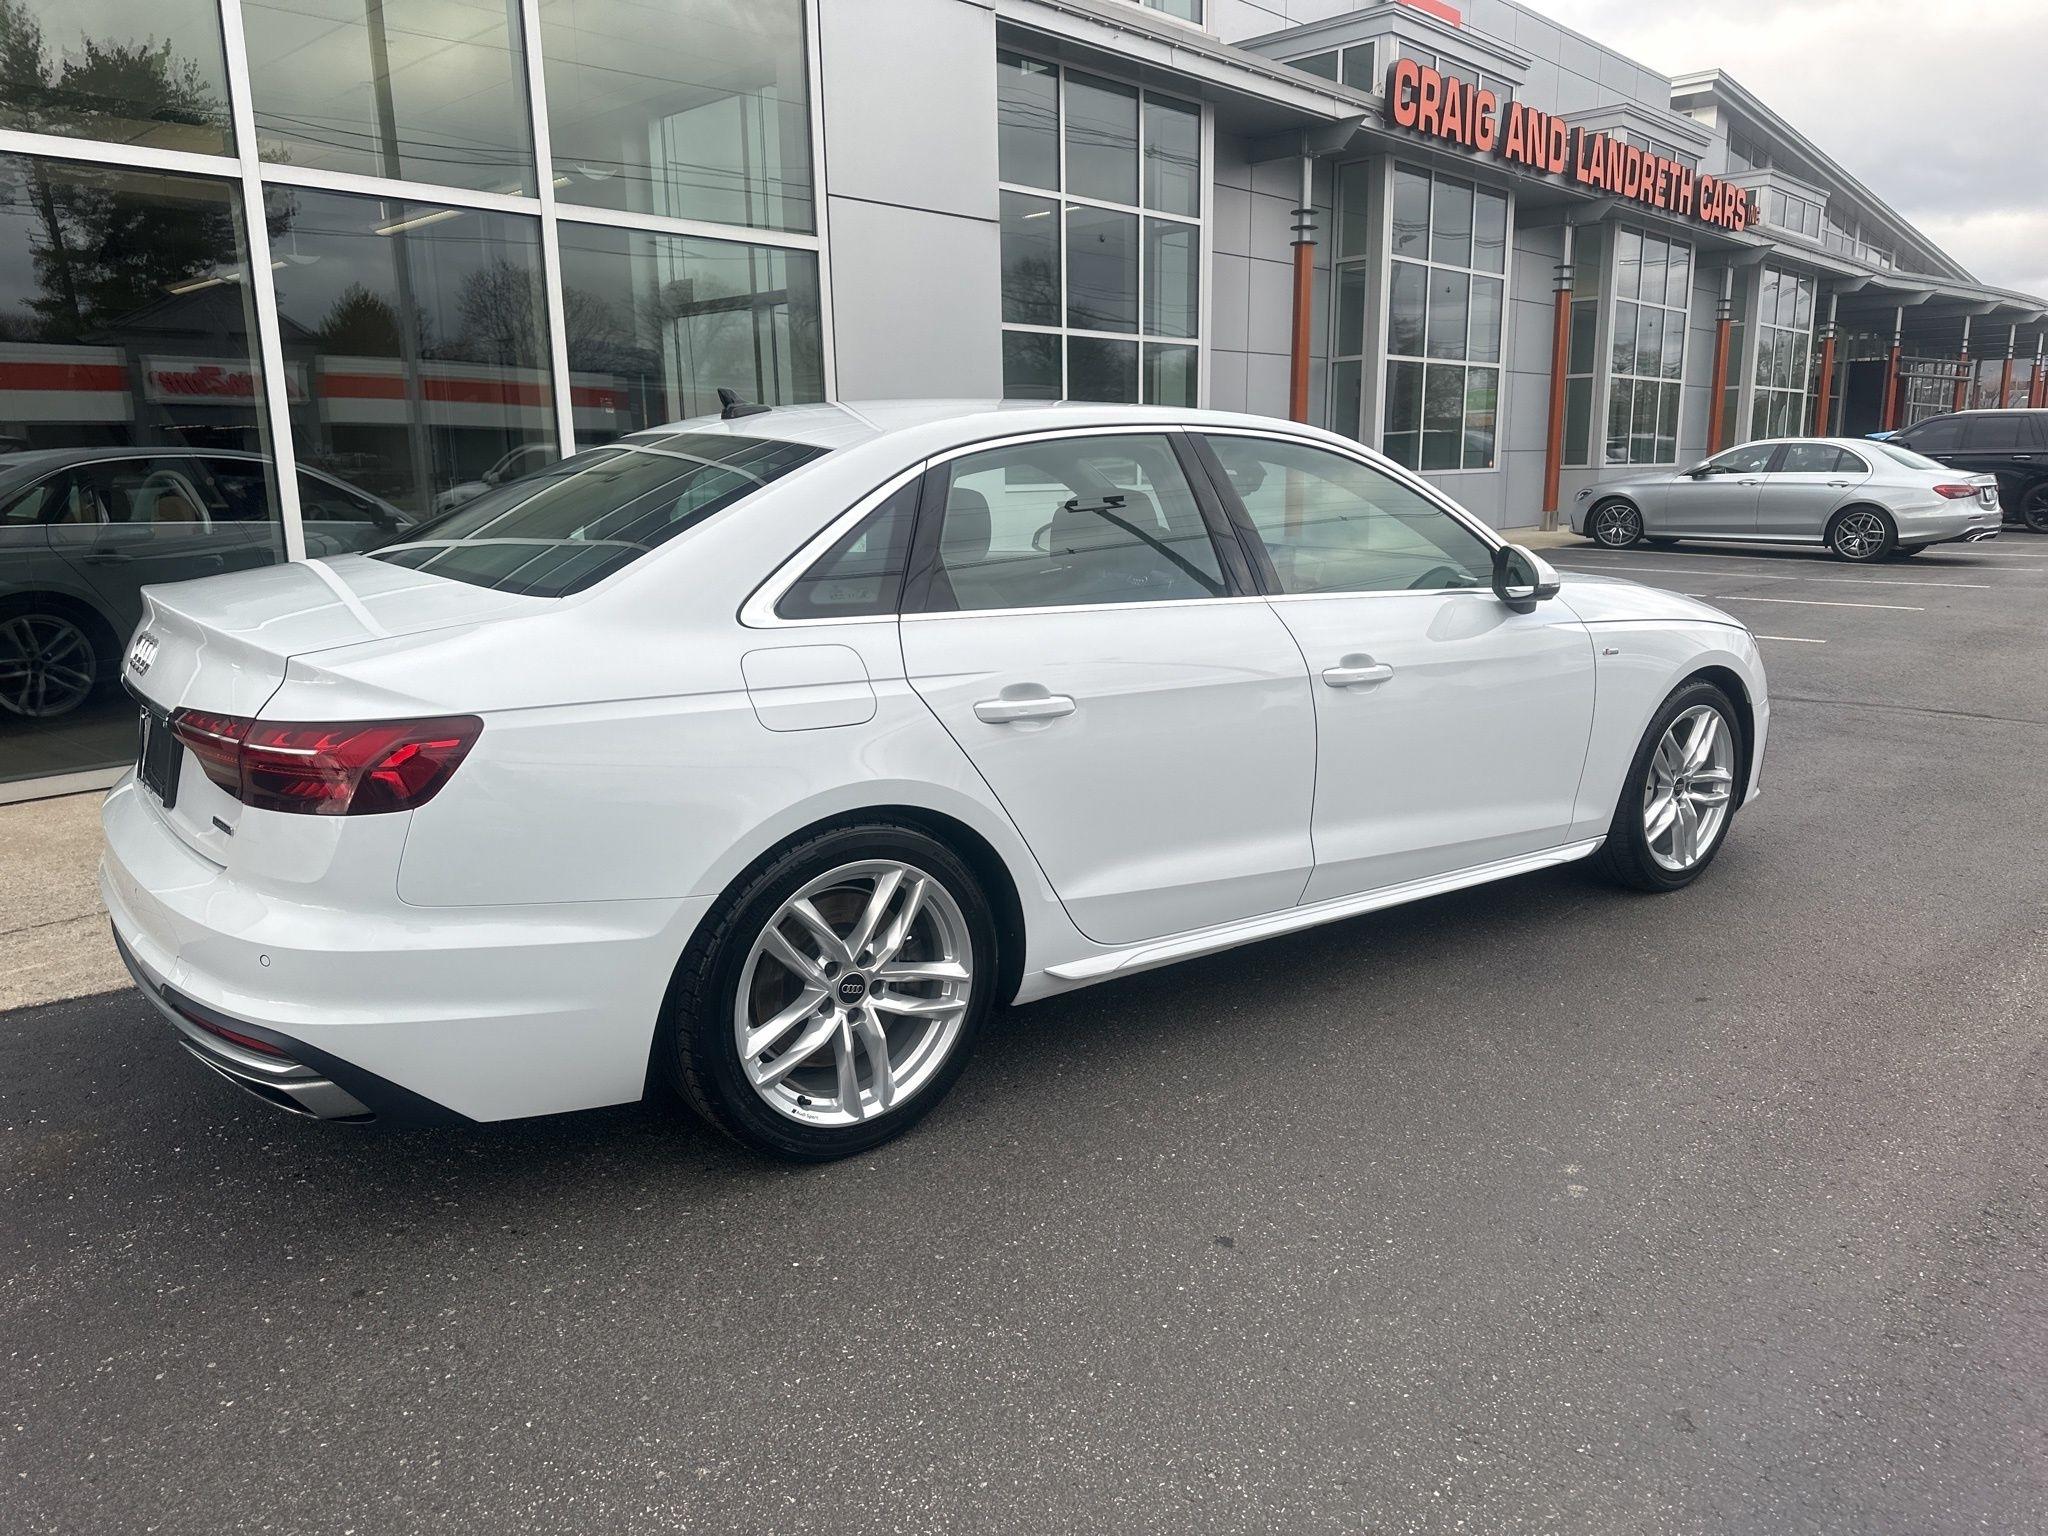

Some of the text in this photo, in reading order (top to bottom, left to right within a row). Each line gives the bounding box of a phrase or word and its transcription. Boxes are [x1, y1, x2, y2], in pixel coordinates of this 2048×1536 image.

[1393, 57, 1497, 152] CRAIG
[1505, 100, 1567, 175] AND
[1576, 126, 1695, 216] LANDRETH
[1700, 173, 1748, 232] CARS
